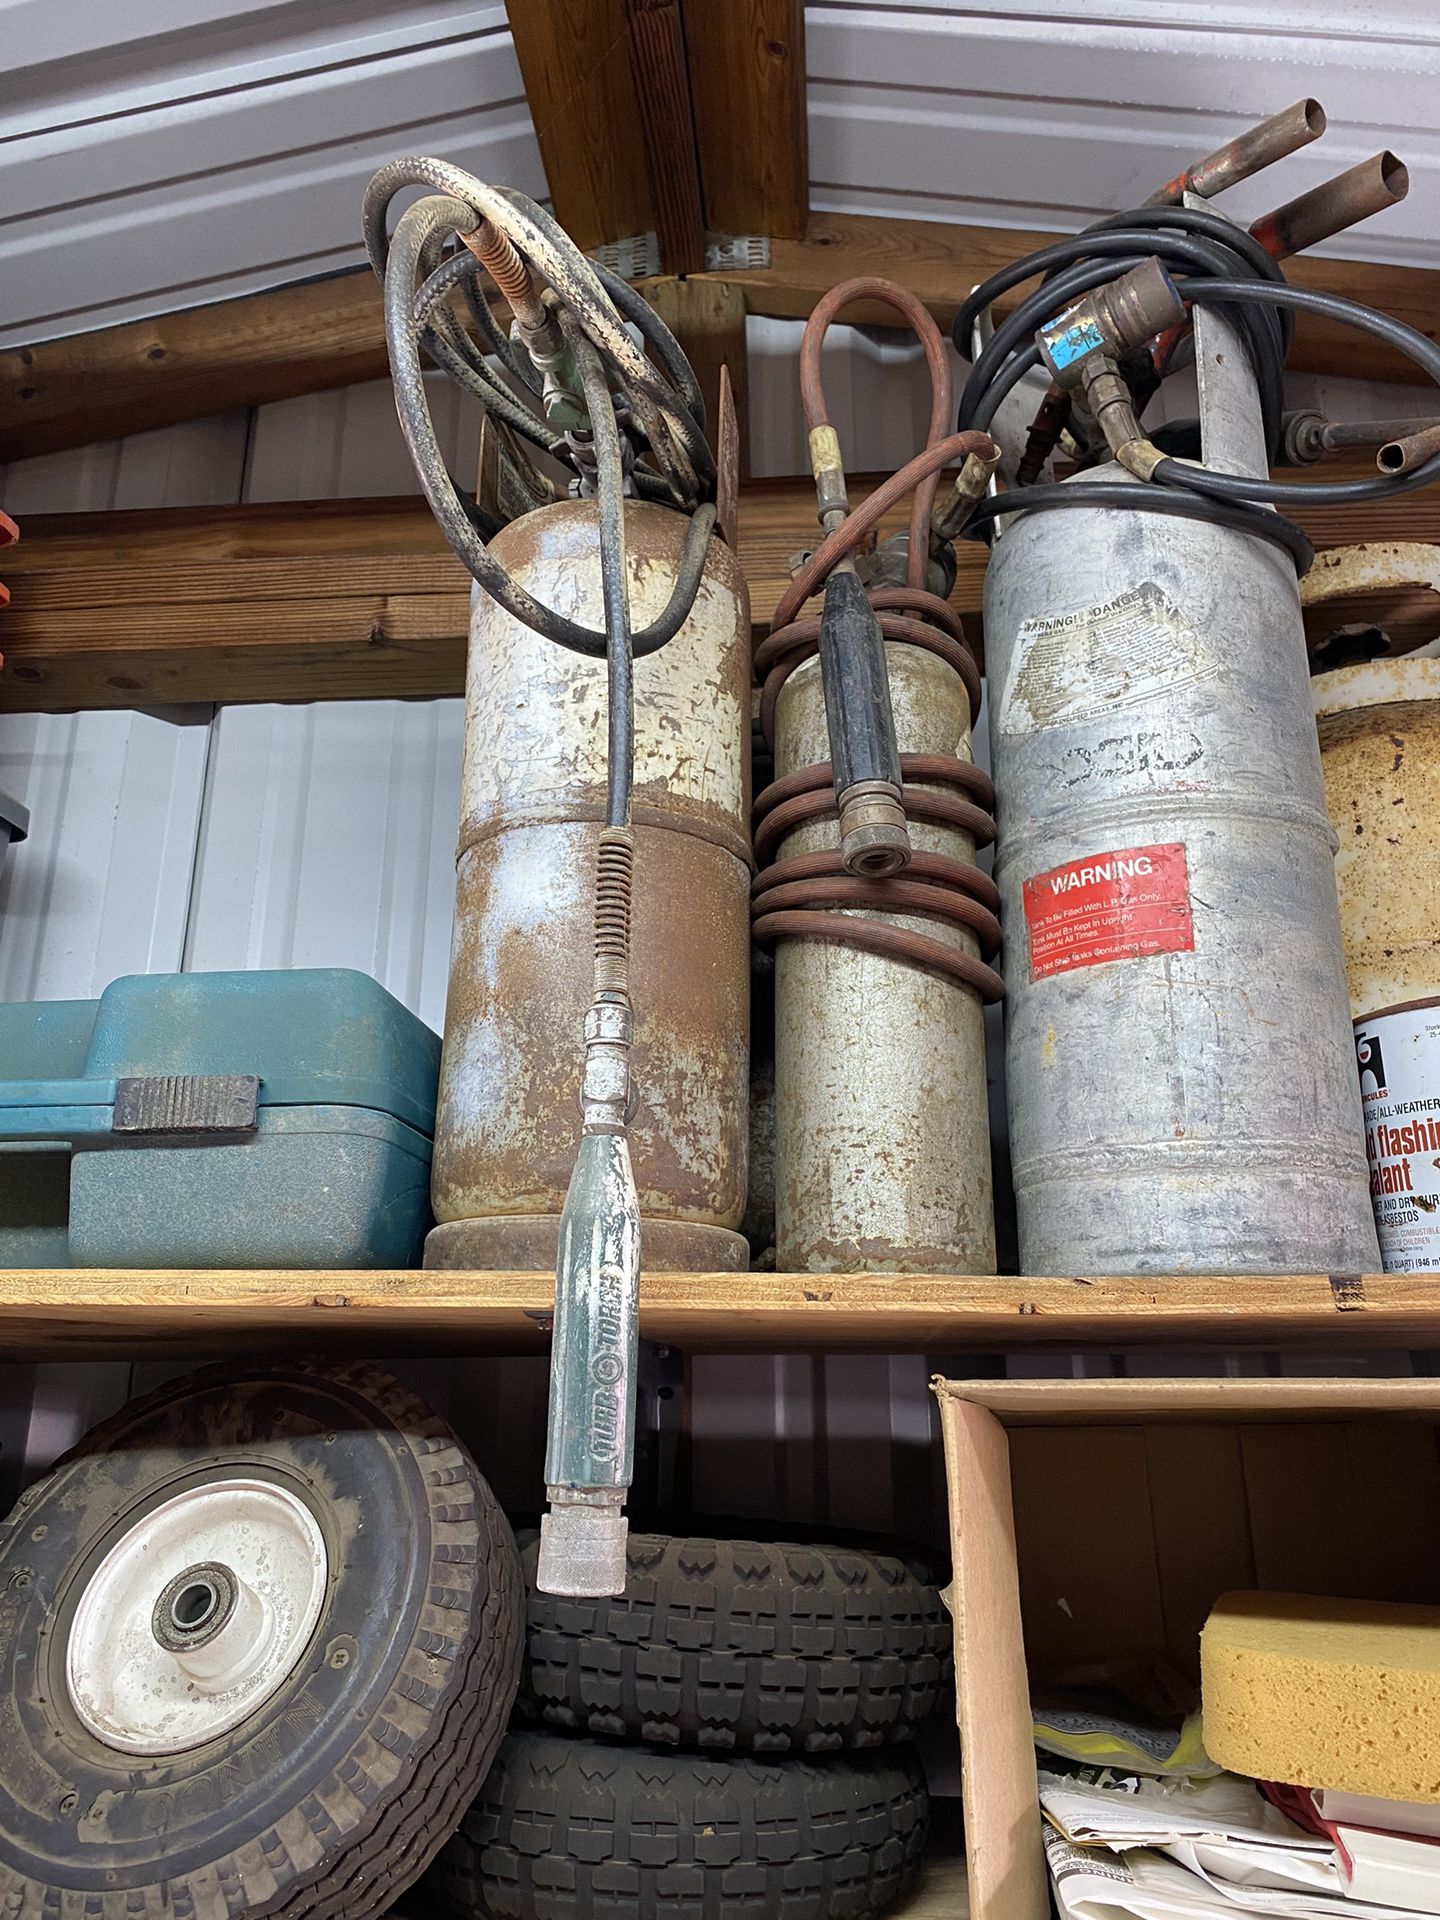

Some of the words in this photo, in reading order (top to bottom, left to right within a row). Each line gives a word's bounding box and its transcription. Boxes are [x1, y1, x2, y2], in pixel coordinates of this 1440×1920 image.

[1093, 589, 1141, 617] DANGE
[1050, 856, 1153, 896] WARNING
[1063, 905, 1083, 919] Filled
[1083, 901, 1102, 913] With
[1045, 929, 1062, 941] Must
[1073, 920, 1092, 933] Kept
[1092, 918, 1101, 928] In
[1101, 912, 1133, 926] Upright
[1064, 933, 1074, 944] All
[1074, 928, 1099, 940] Times.
[1033, 965, 1043, 974] Do
[1042, 960, 1054, 970] Not
[1383, 1198, 1397, 1211] AND
[1417, 1193, 1440, 1207] SUR
[1402, 1236, 1431, 1247] CHILDREN
